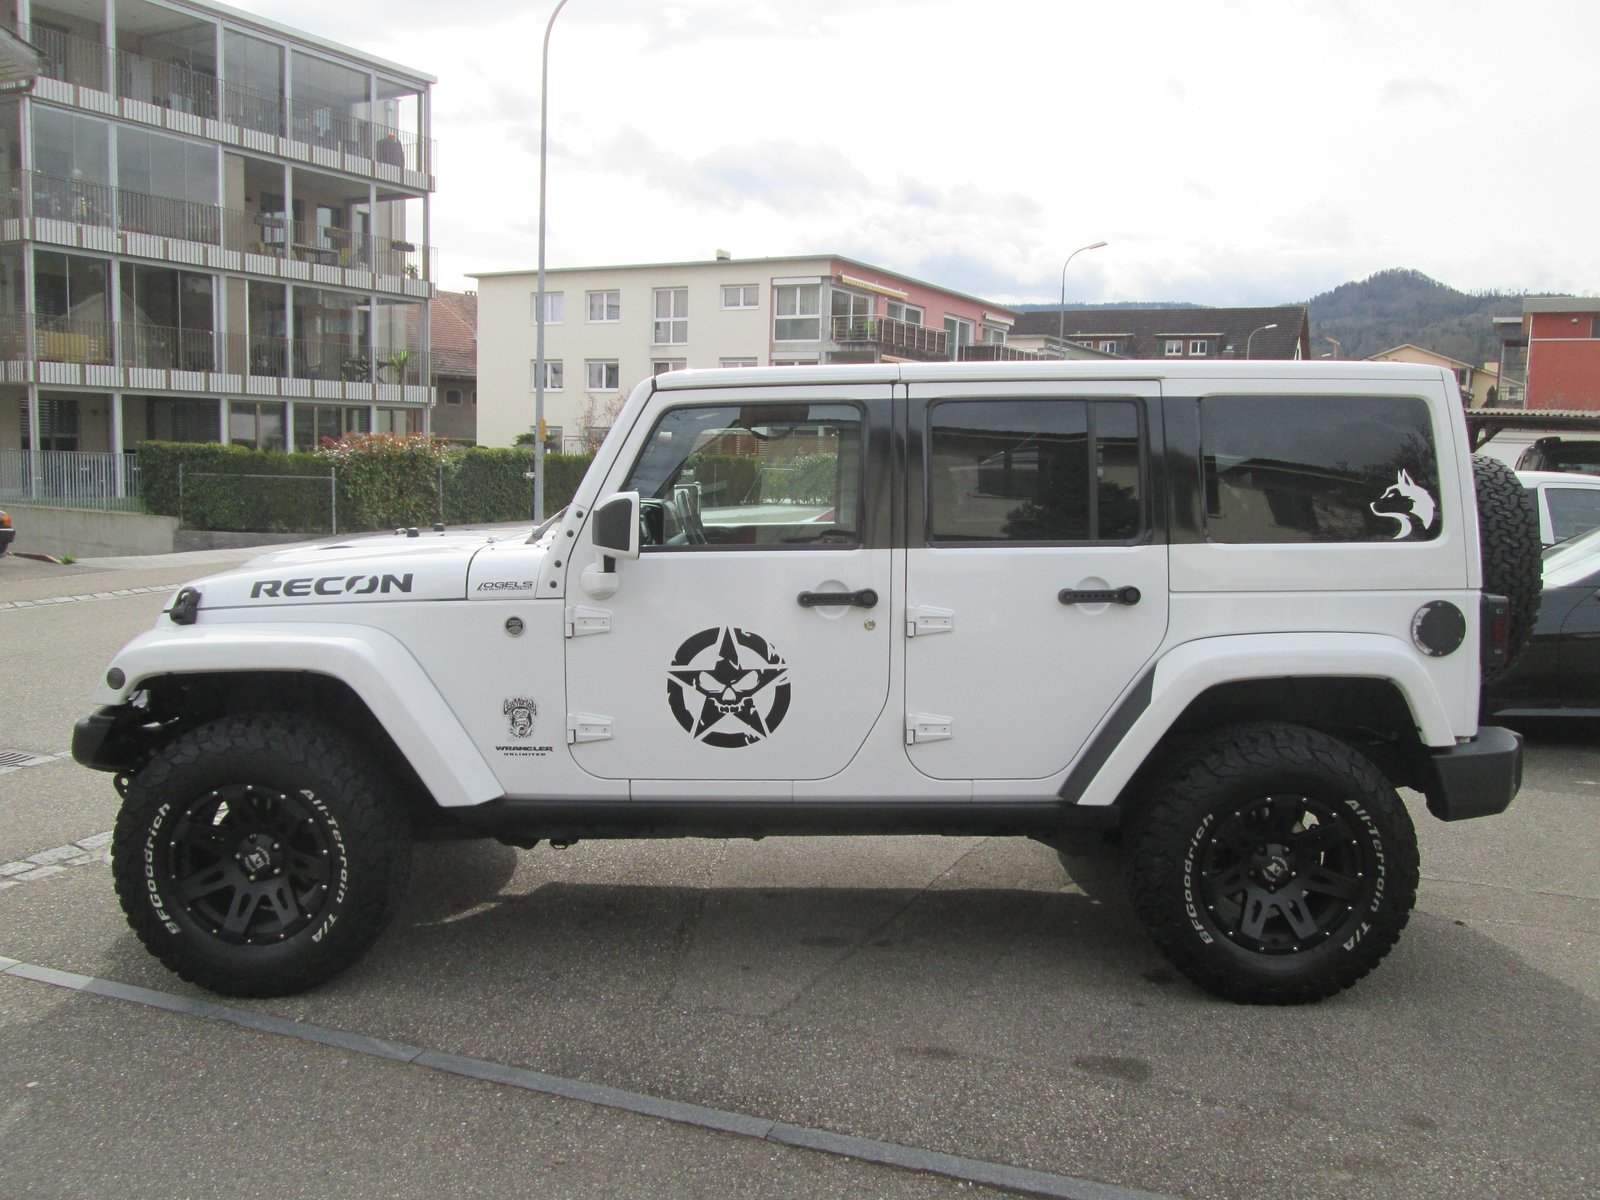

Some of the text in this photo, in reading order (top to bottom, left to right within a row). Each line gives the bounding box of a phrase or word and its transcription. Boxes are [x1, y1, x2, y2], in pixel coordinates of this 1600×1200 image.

[250, 573, 414, 599] RECON
[143, 802, 182, 935] BFGoodrich
[299, 789, 349, 944] All-Terrain T/A
[1183, 813, 1215, 945] BFGoodrich
[1342, 799, 1386, 952] All-Terrain T/A
